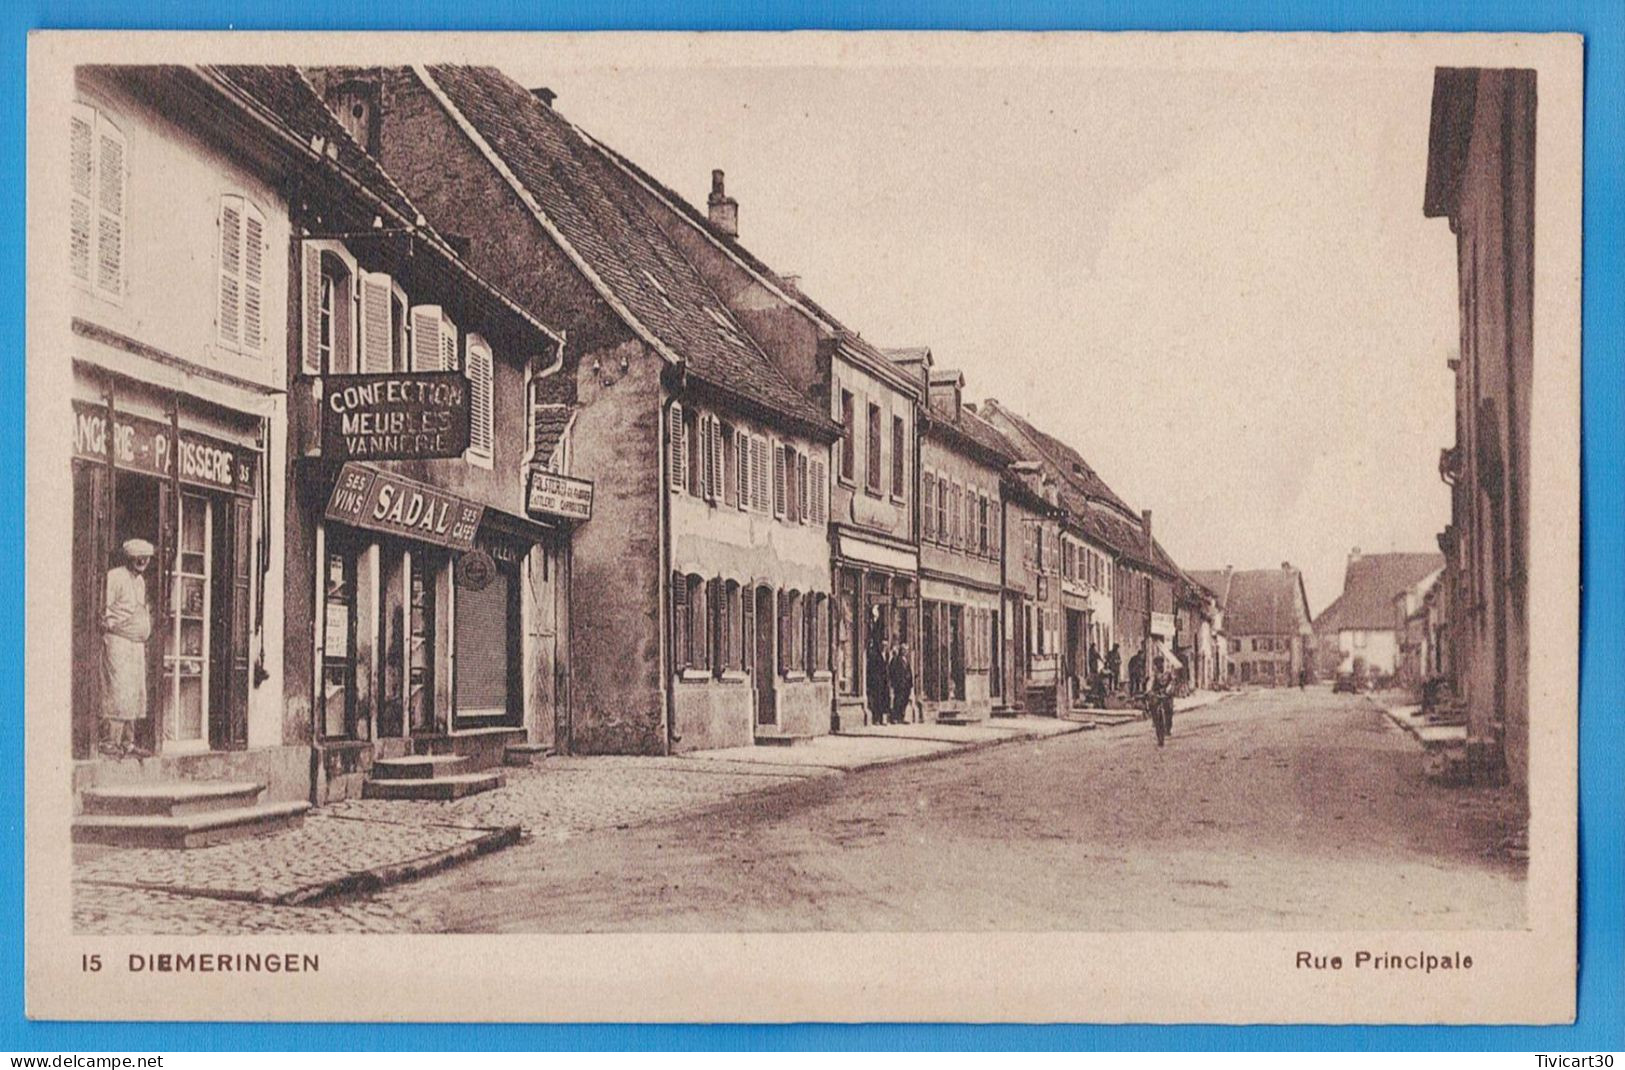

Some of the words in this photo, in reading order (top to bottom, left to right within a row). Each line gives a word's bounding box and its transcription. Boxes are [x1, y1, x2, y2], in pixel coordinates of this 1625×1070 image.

[330, 381, 461, 413] CONFECTION
[342, 411, 451, 435] MEUBLES
[346, 472, 366, 491] SES
[334, 488, 364, 514] VINS
[373, 484, 449, 535] SADAL
[462, 508, 478, 523] SES
[82, 954, 102, 972] 15
[128, 953, 319, 973] DIEMERINGEN
[1296, 951, 1343, 970] Rue
[1355, 950, 1473, 973] Principale
